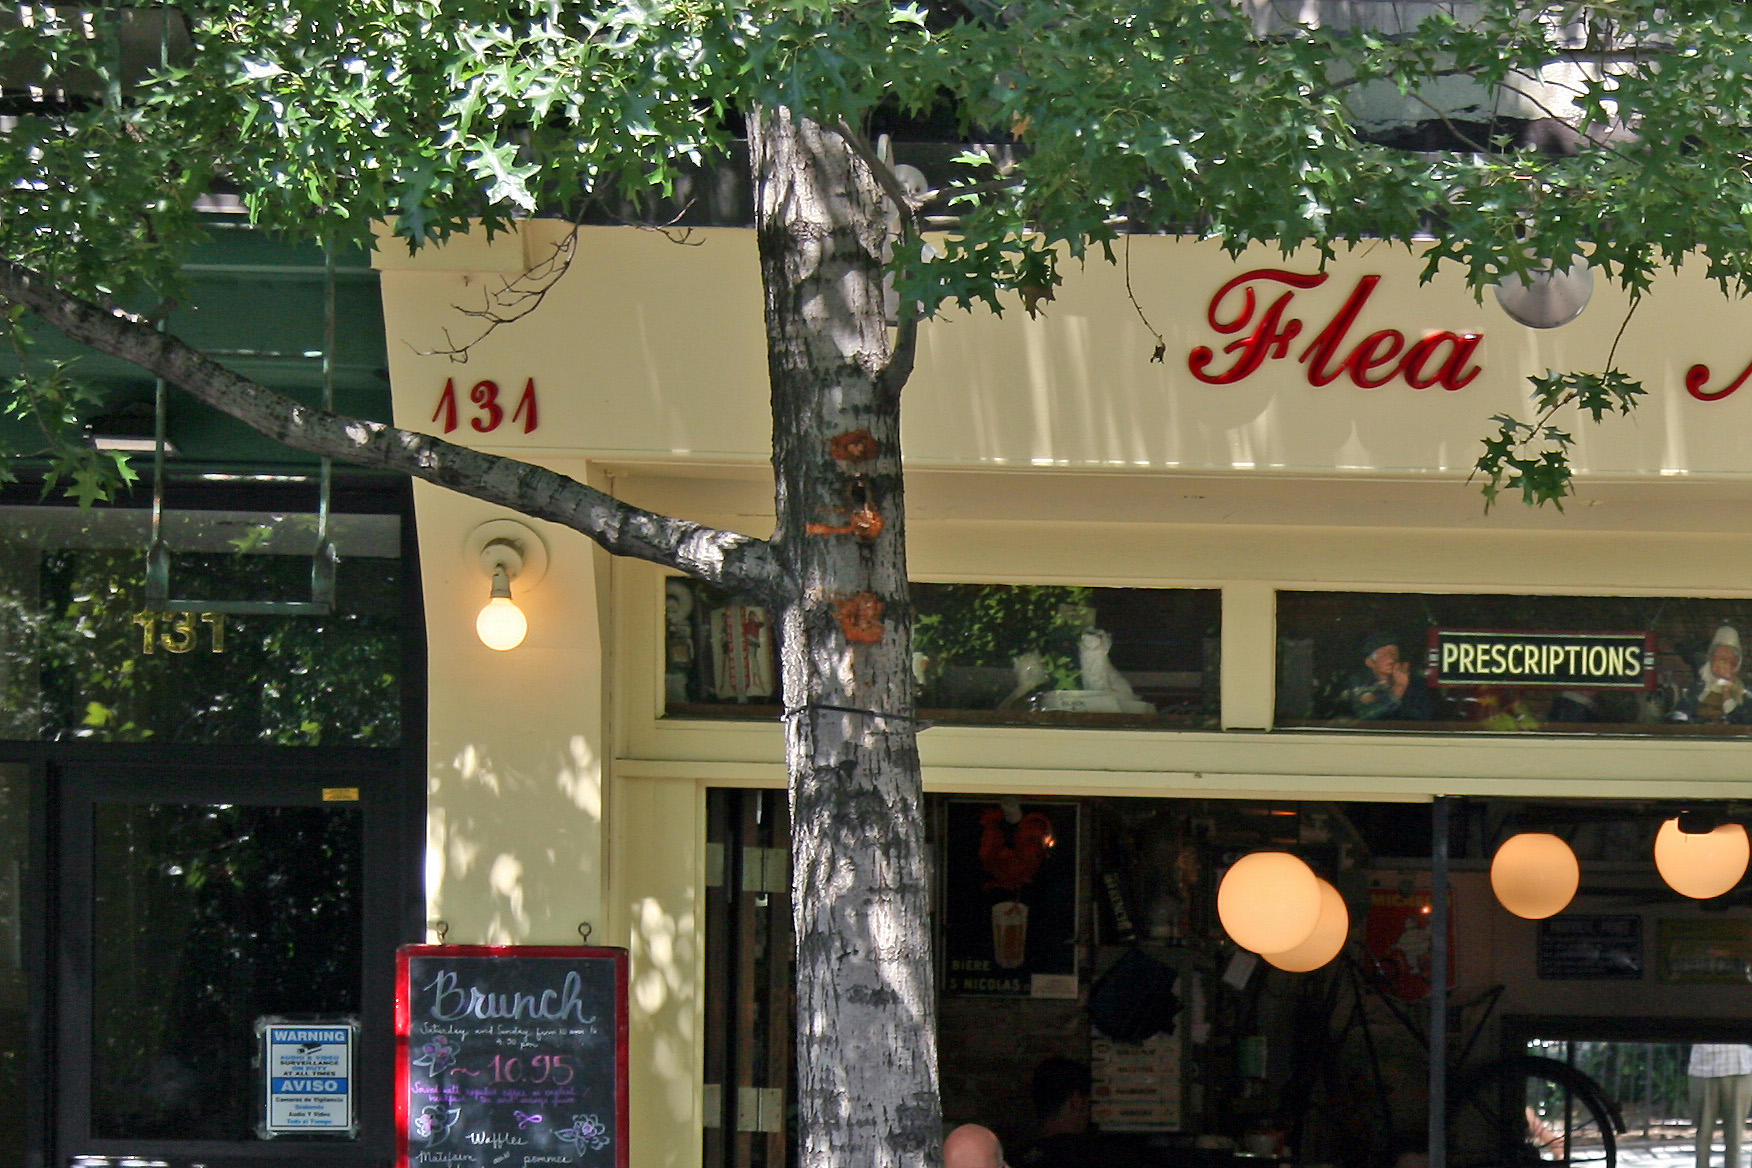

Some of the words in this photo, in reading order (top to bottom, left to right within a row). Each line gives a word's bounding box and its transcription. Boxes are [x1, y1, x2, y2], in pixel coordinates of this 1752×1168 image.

[1188, 268, 1485, 391] Flea
[432, 377, 539, 434] 131
[133, 610, 225, 654] 131
[1442, 643, 1641, 676] PRESCRIPTIONS
[424, 970, 597, 1024] Brunch
[274, 1030, 345, 1042] WARNING
[281, 1080, 338, 1092] AVISO
[488, 1054, 575, 1086] 10.95
[465, 1131, 529, 1149] Waffles
